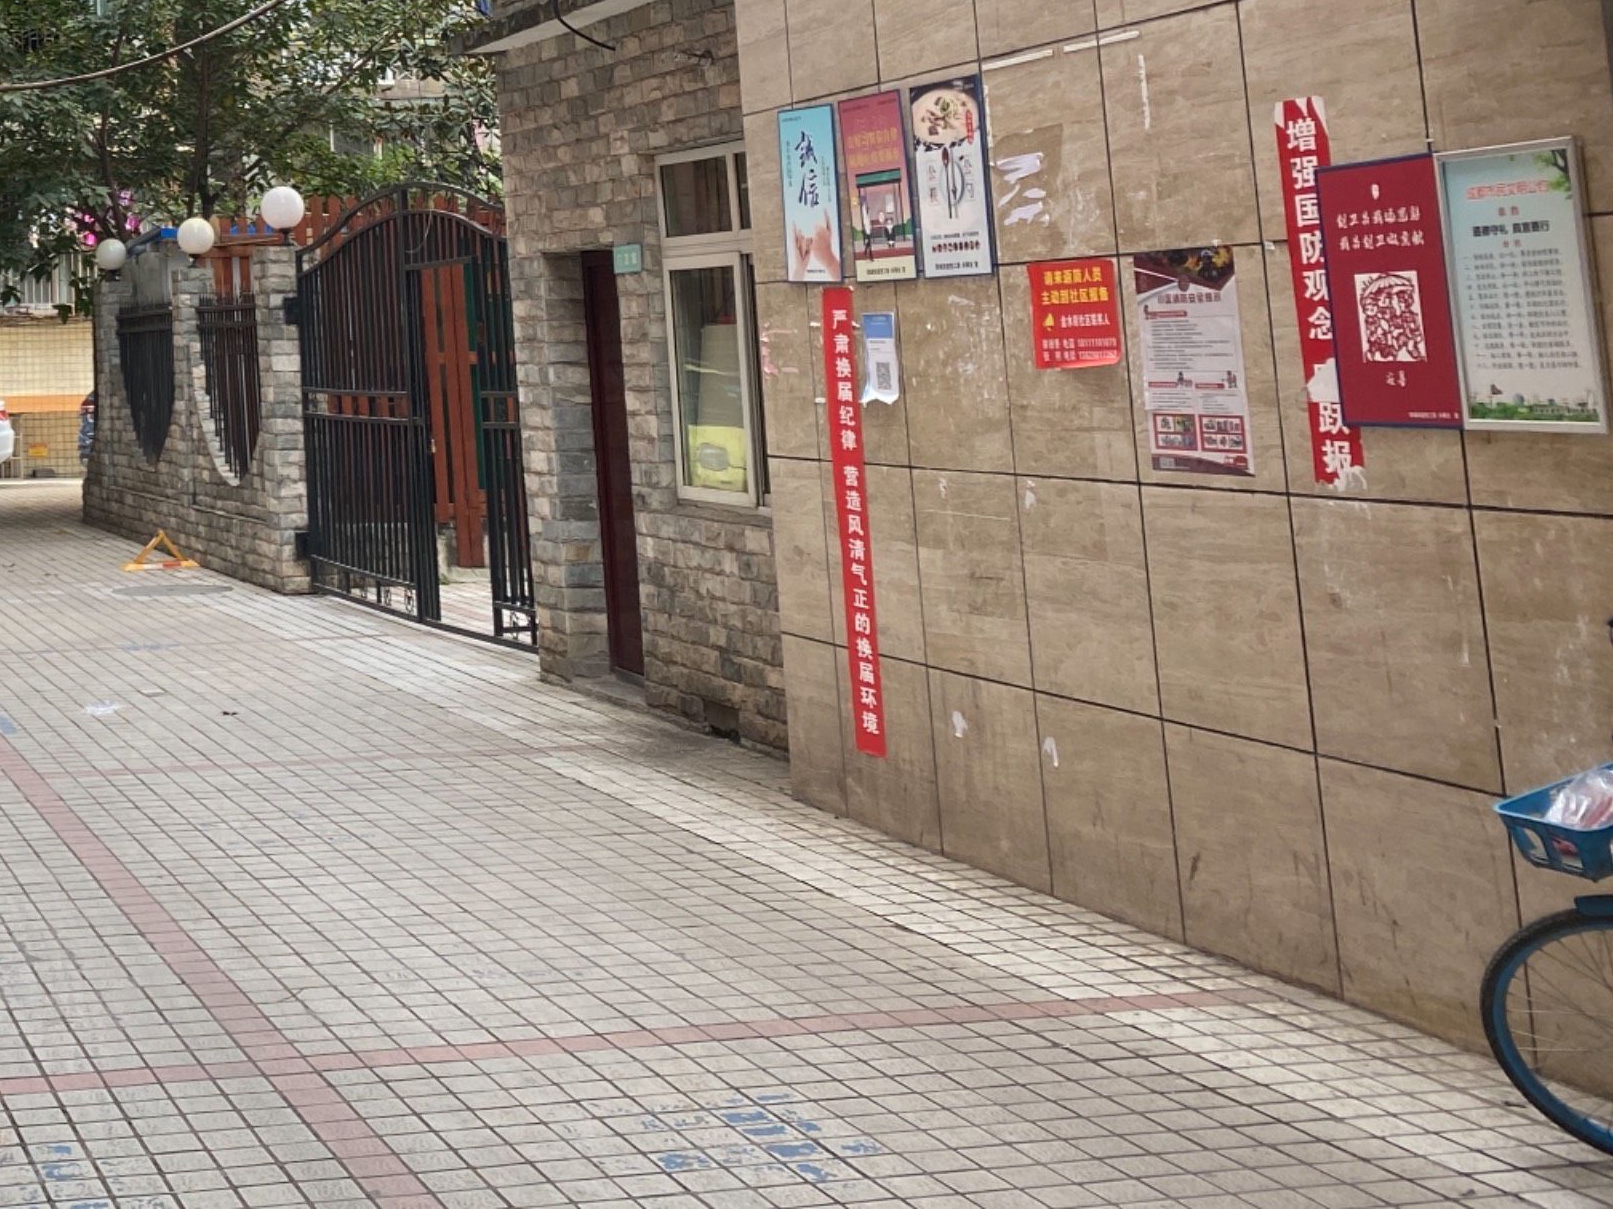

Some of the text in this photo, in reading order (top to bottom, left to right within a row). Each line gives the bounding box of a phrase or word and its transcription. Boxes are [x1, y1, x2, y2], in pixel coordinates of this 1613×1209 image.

[1287, 117, 1333, 340] 增强国防观念
[832, 309, 880, 735] 严肃换届纪律 营造风清气正的换届环境
